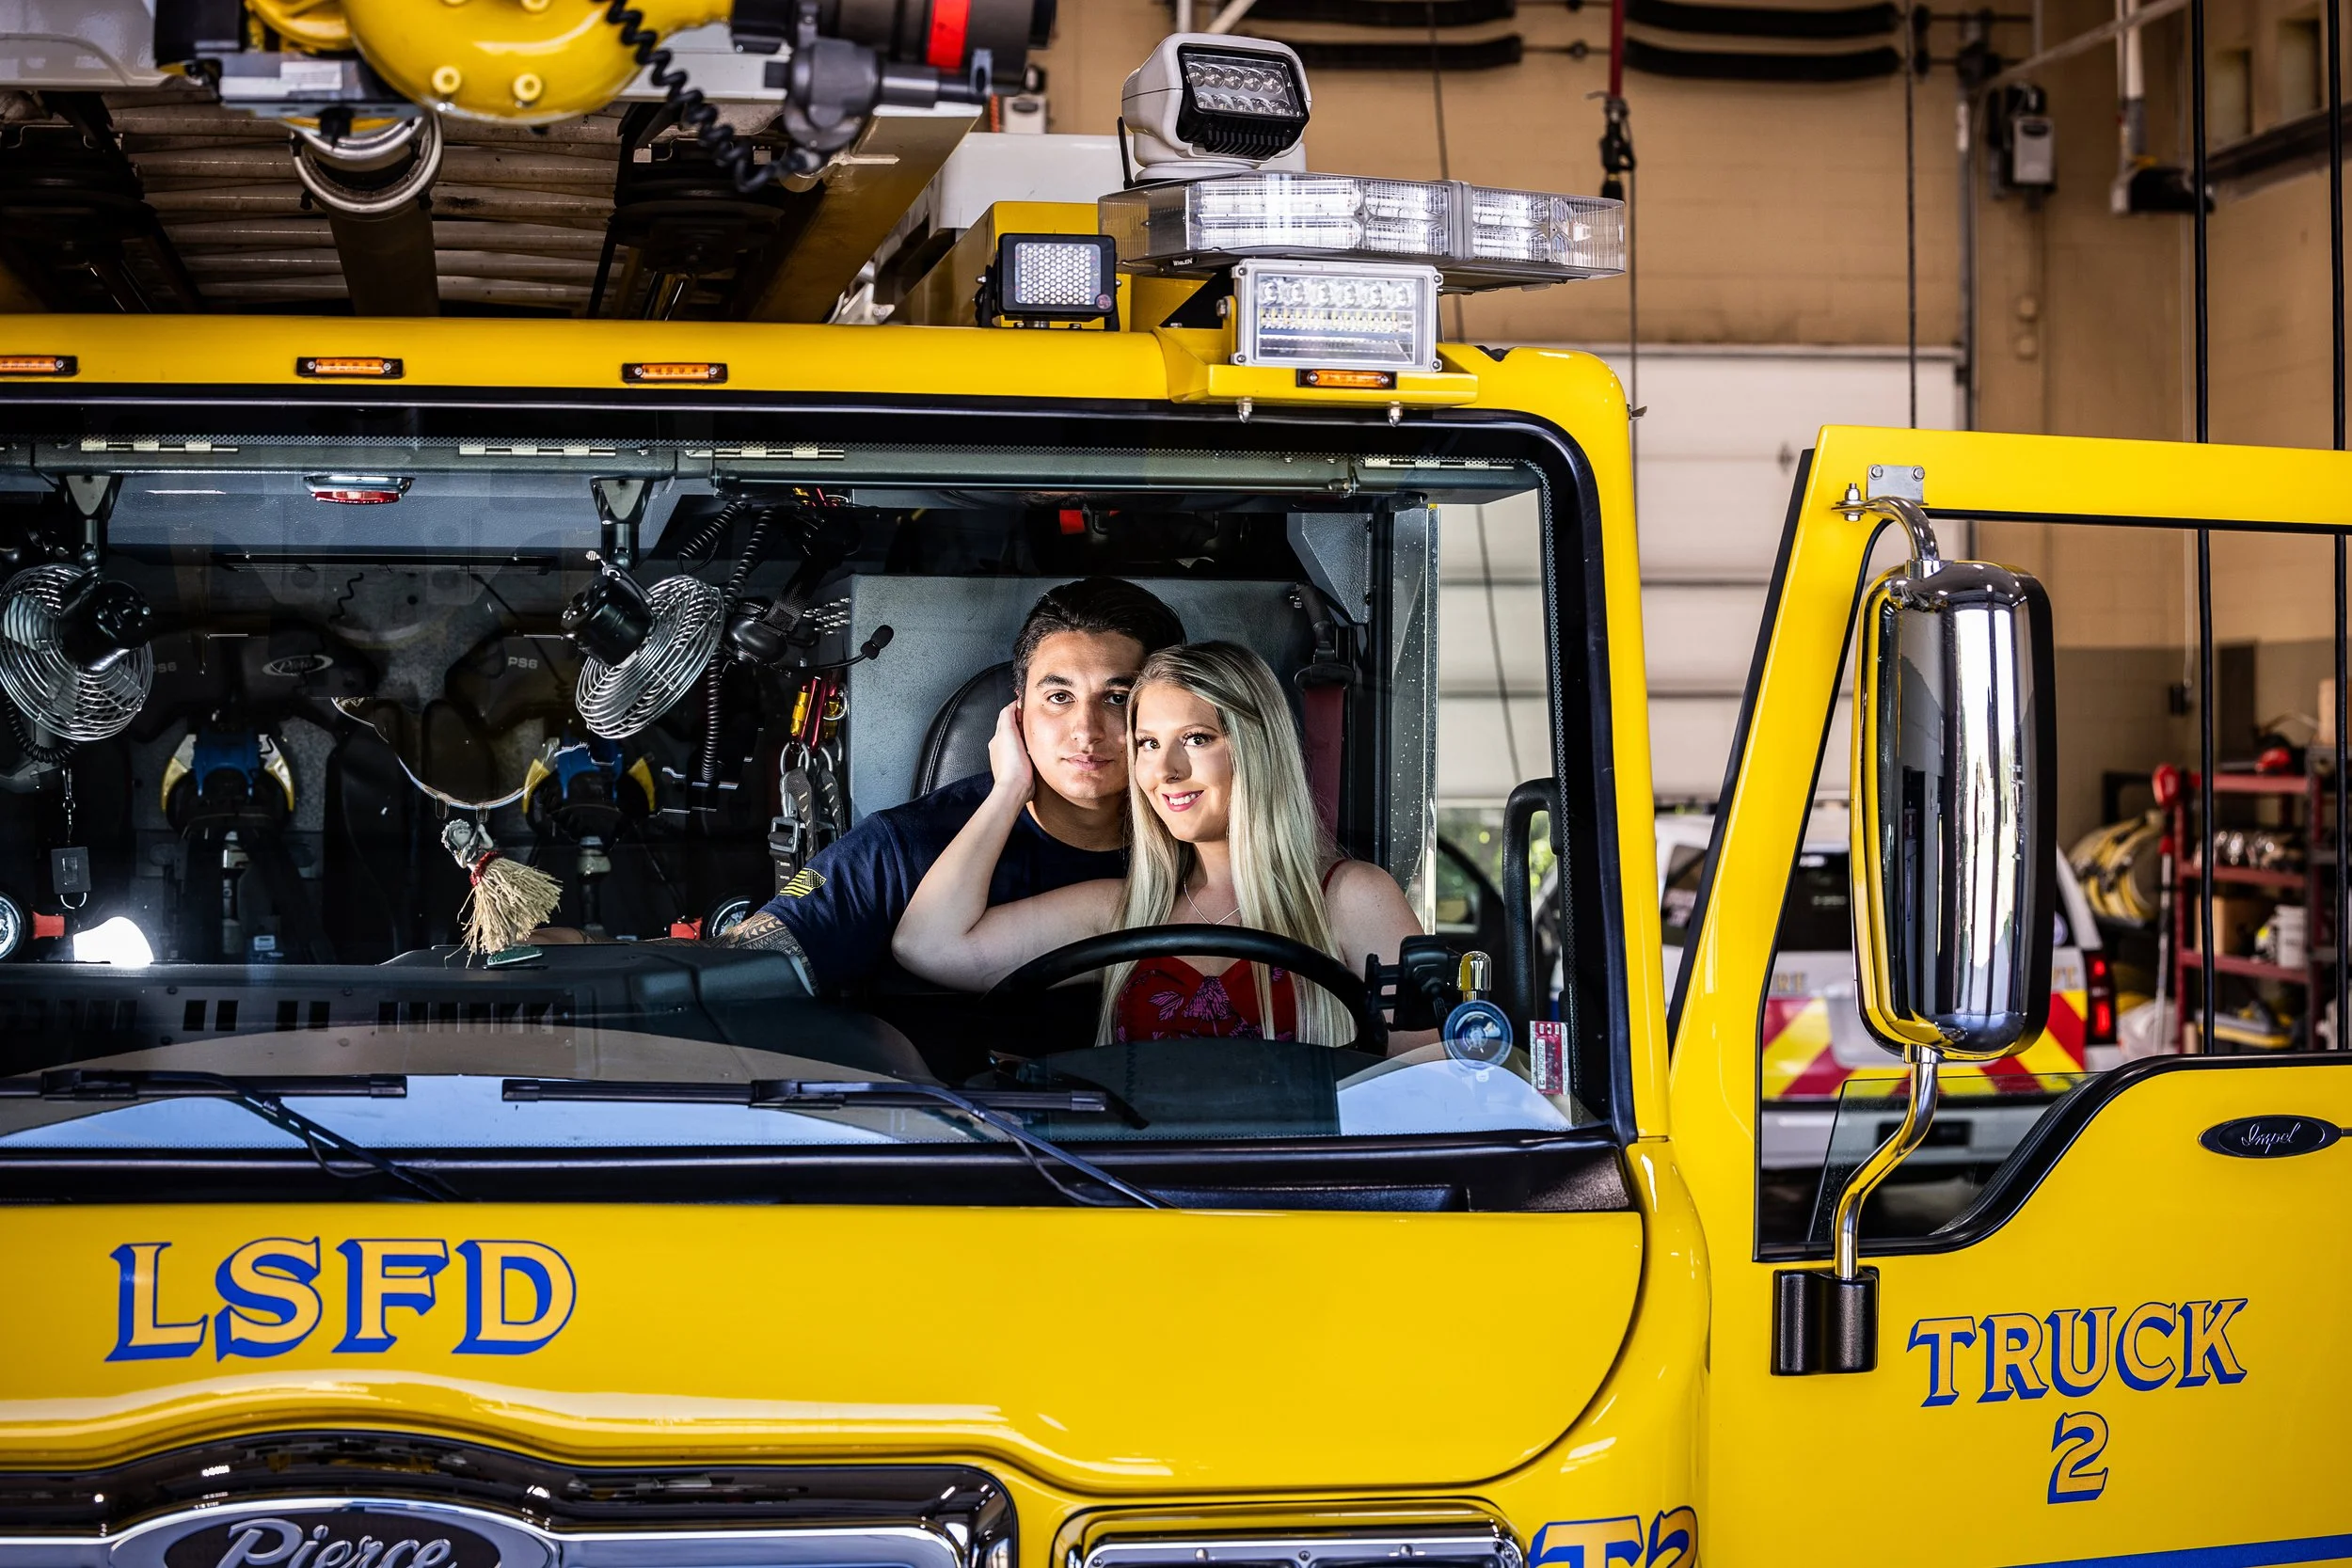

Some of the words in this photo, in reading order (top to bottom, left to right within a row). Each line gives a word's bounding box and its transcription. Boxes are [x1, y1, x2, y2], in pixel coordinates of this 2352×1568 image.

[508, 656, 538, 669] PS6
[2241, 1122, 2301, 1154] Impel
[103, 1236, 577, 1362] LSFD
[1906, 1298, 2249, 1407] TRUCK
[2047, 1411, 2108, 1504] 2
